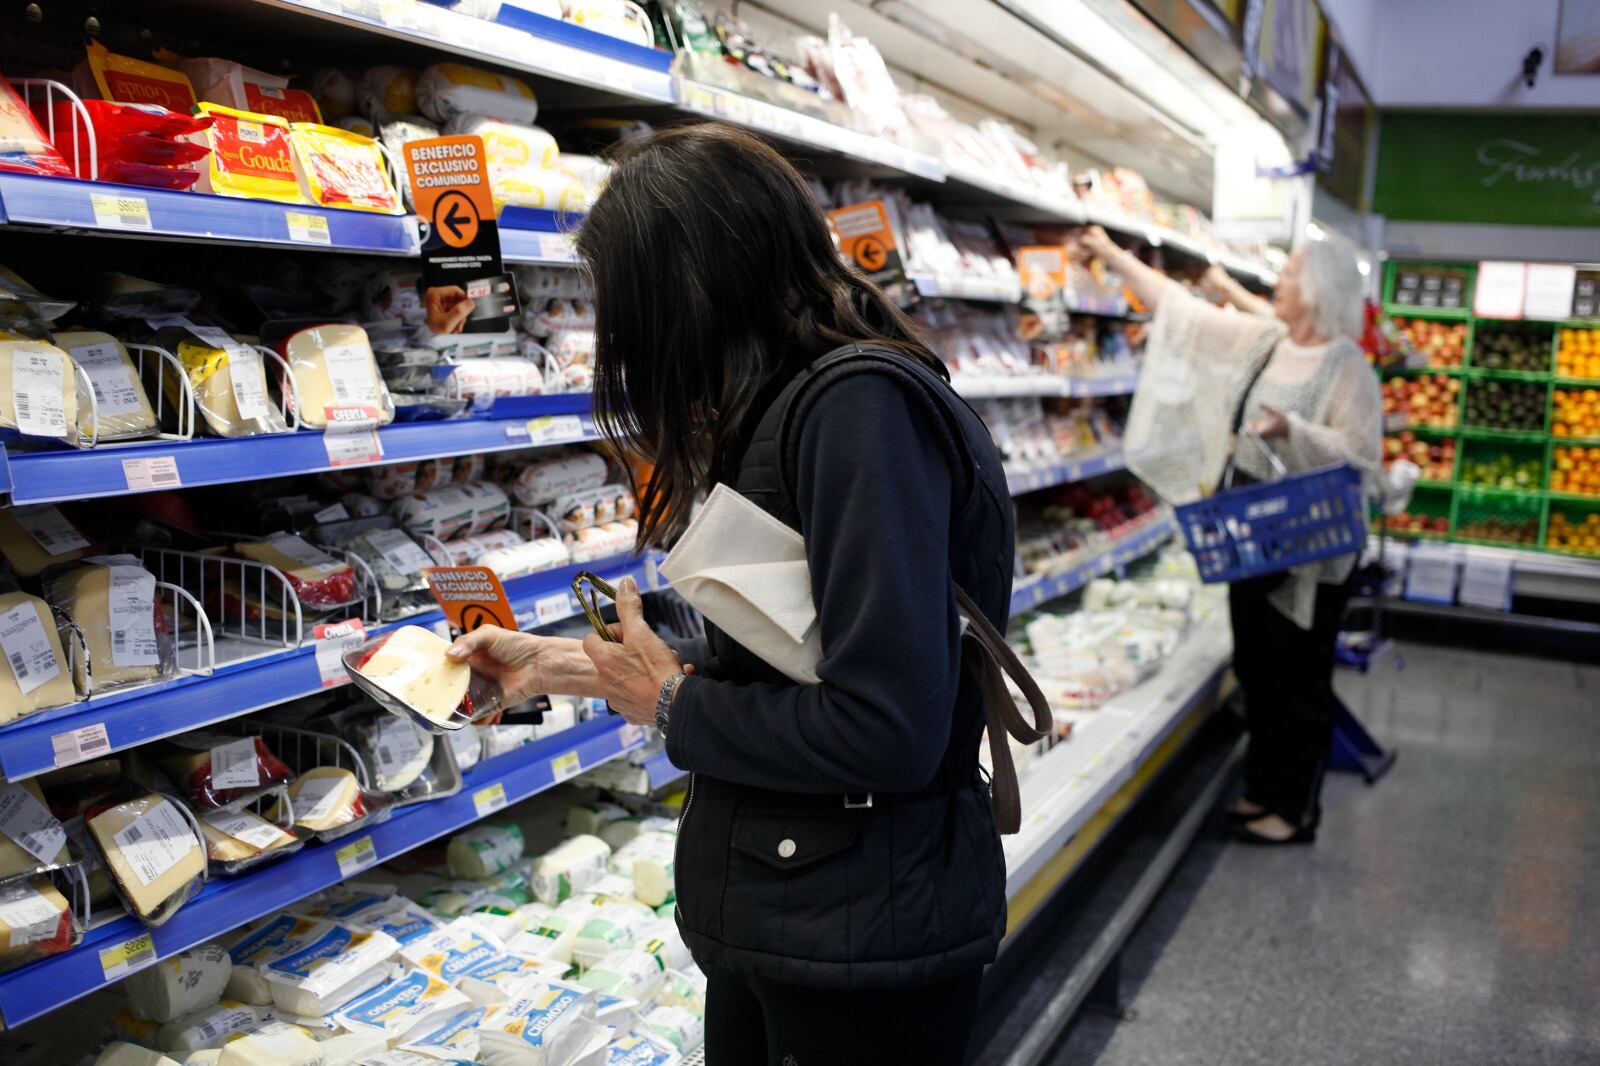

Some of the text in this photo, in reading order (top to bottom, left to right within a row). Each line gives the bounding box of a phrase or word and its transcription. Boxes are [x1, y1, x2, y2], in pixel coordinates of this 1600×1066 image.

[239, 145, 295, 173] Gouda
[411, 143, 477, 161] BENEFICIO
[413, 159, 479, 175] EXCLUSIVO
[416, 173, 481, 188] COMUNIDAD
[332, 408, 369, 422] OFERTA
[430, 570, 488, 581] BENEFICIO
[434, 580, 494, 592] EXCLUSIVO
[440, 591, 499, 602] COMUNIDAD
[366, 983, 424, 1017] CREMOSO
[528, 995, 574, 1037] CREMOSO
